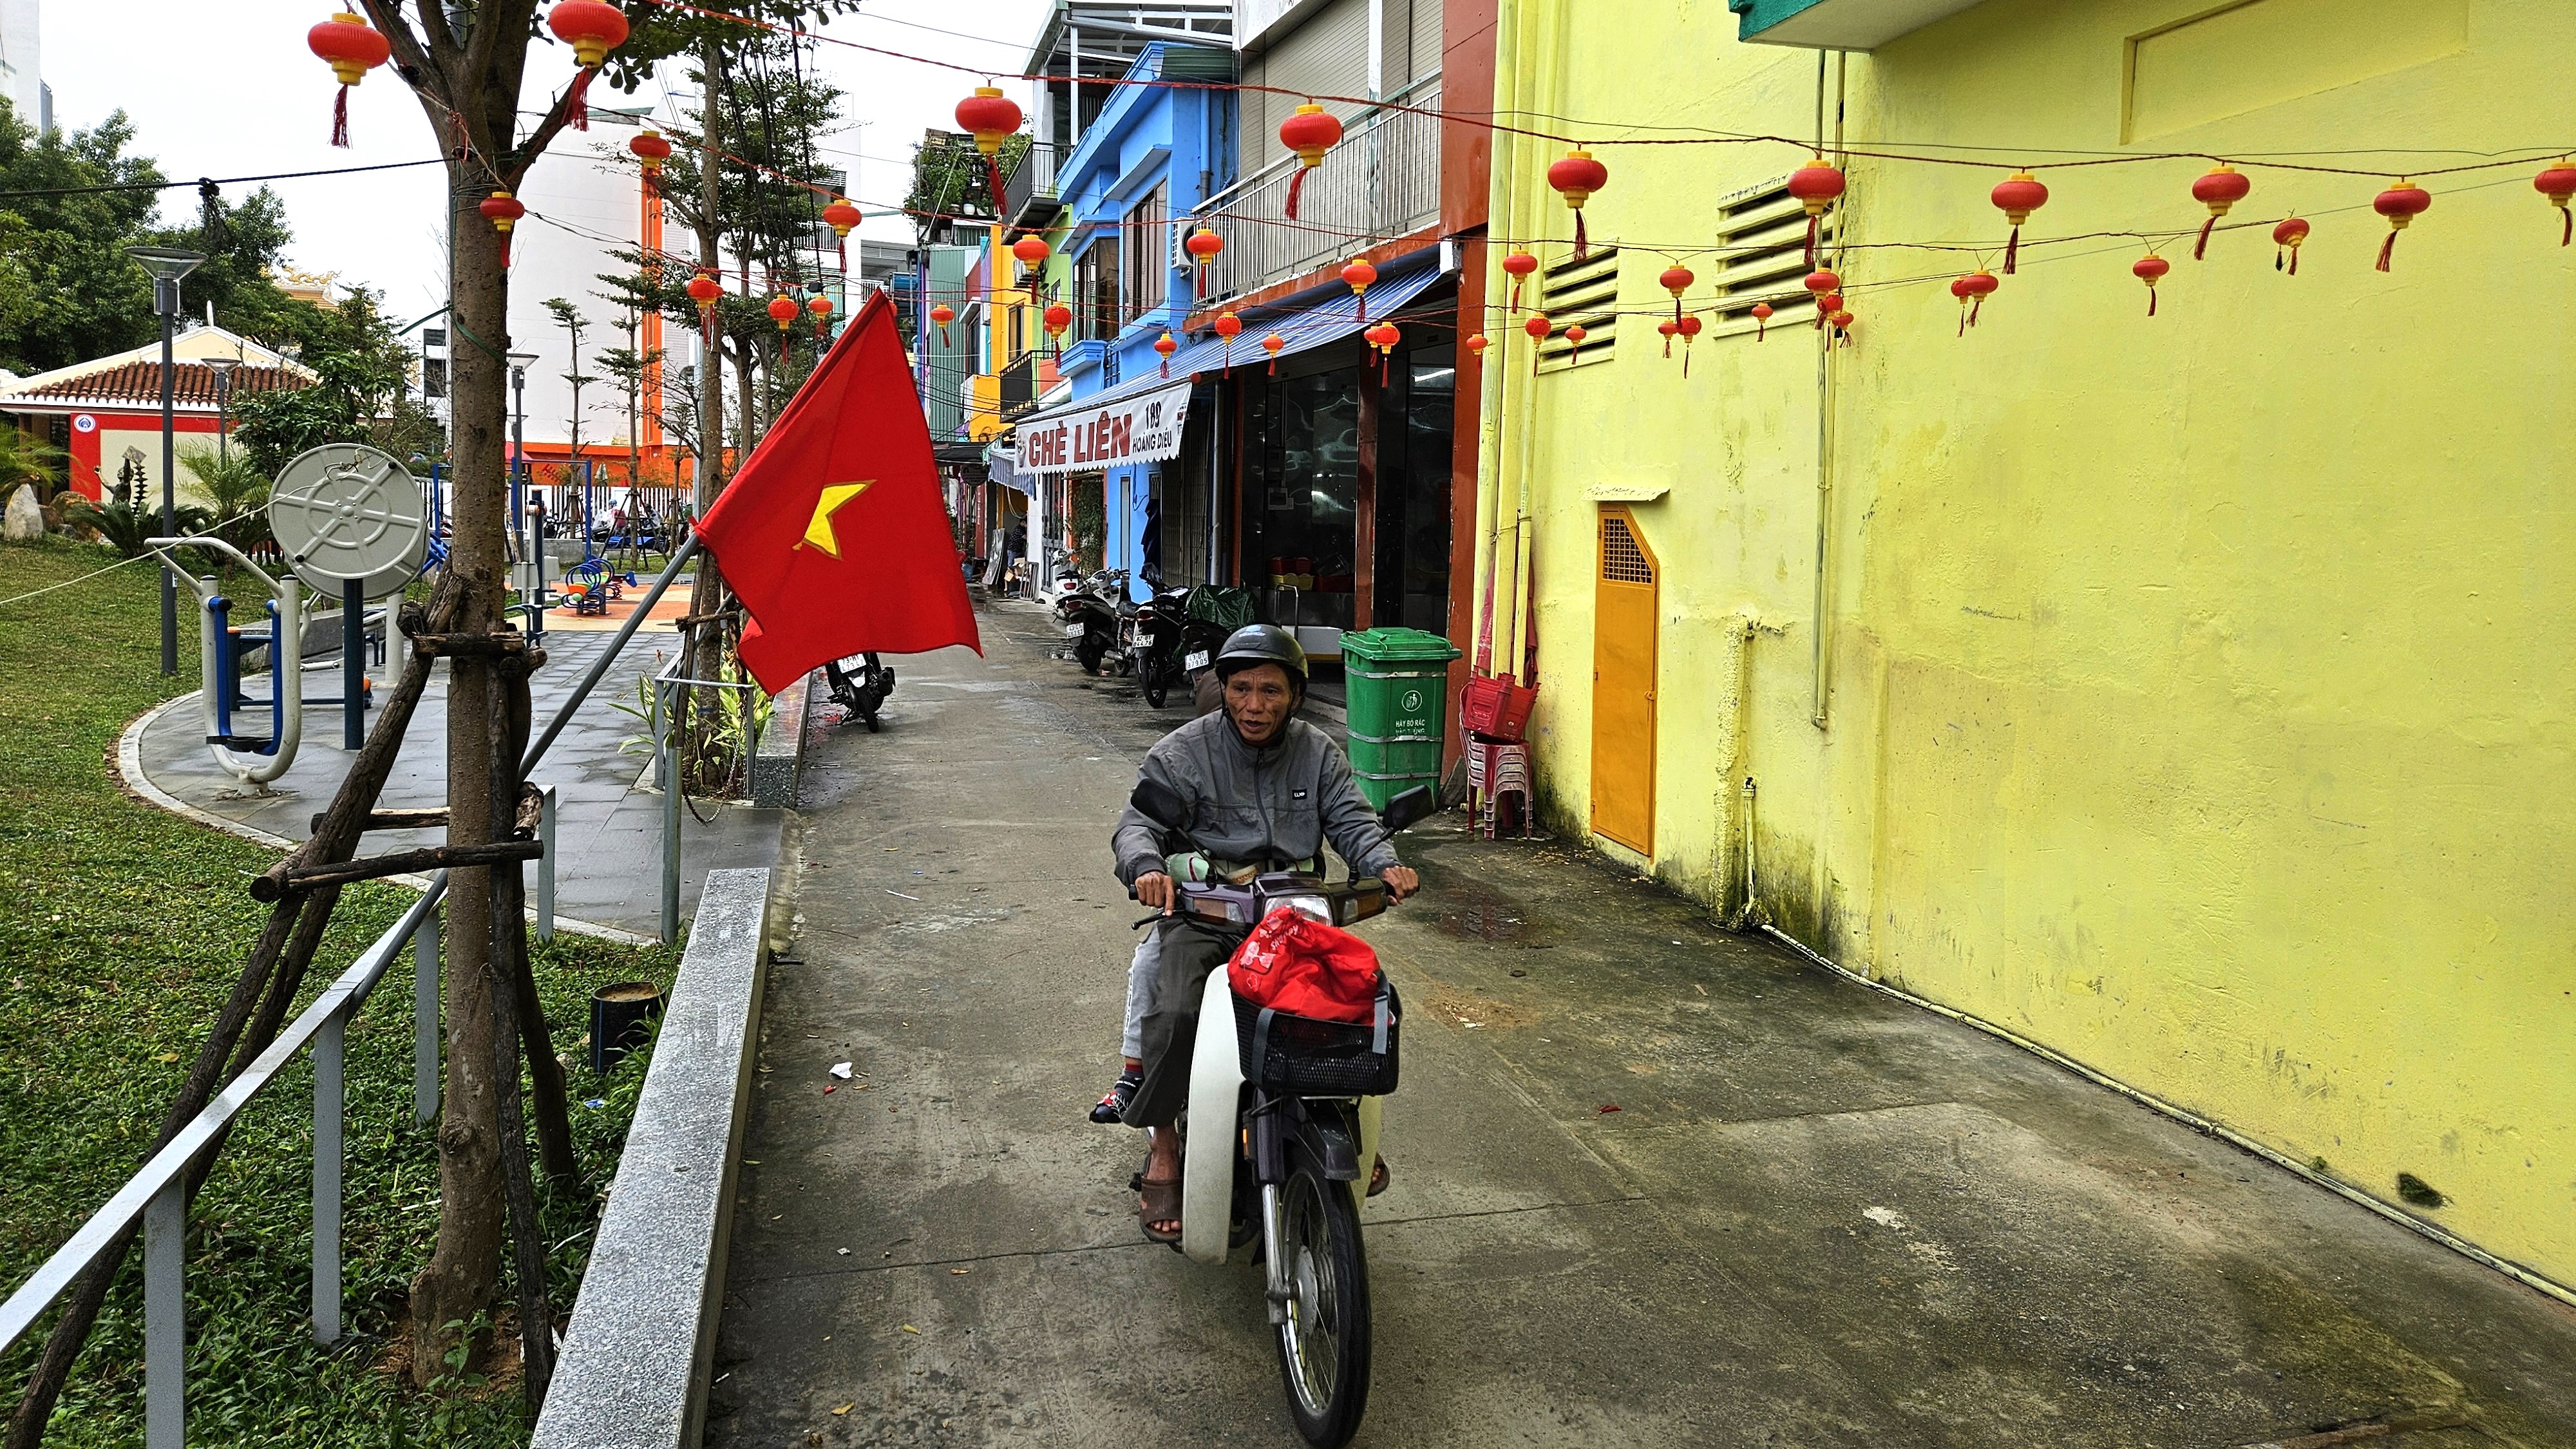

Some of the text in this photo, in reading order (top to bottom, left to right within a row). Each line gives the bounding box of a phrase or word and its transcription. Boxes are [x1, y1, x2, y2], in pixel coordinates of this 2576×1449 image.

[1146, 401, 1162, 430] 189
[1028, 421, 1068, 467] CHÈ
[1074, 410, 1132, 463] LIÊN
[1132, 426, 1172, 454] HOÀNG DIỆU
